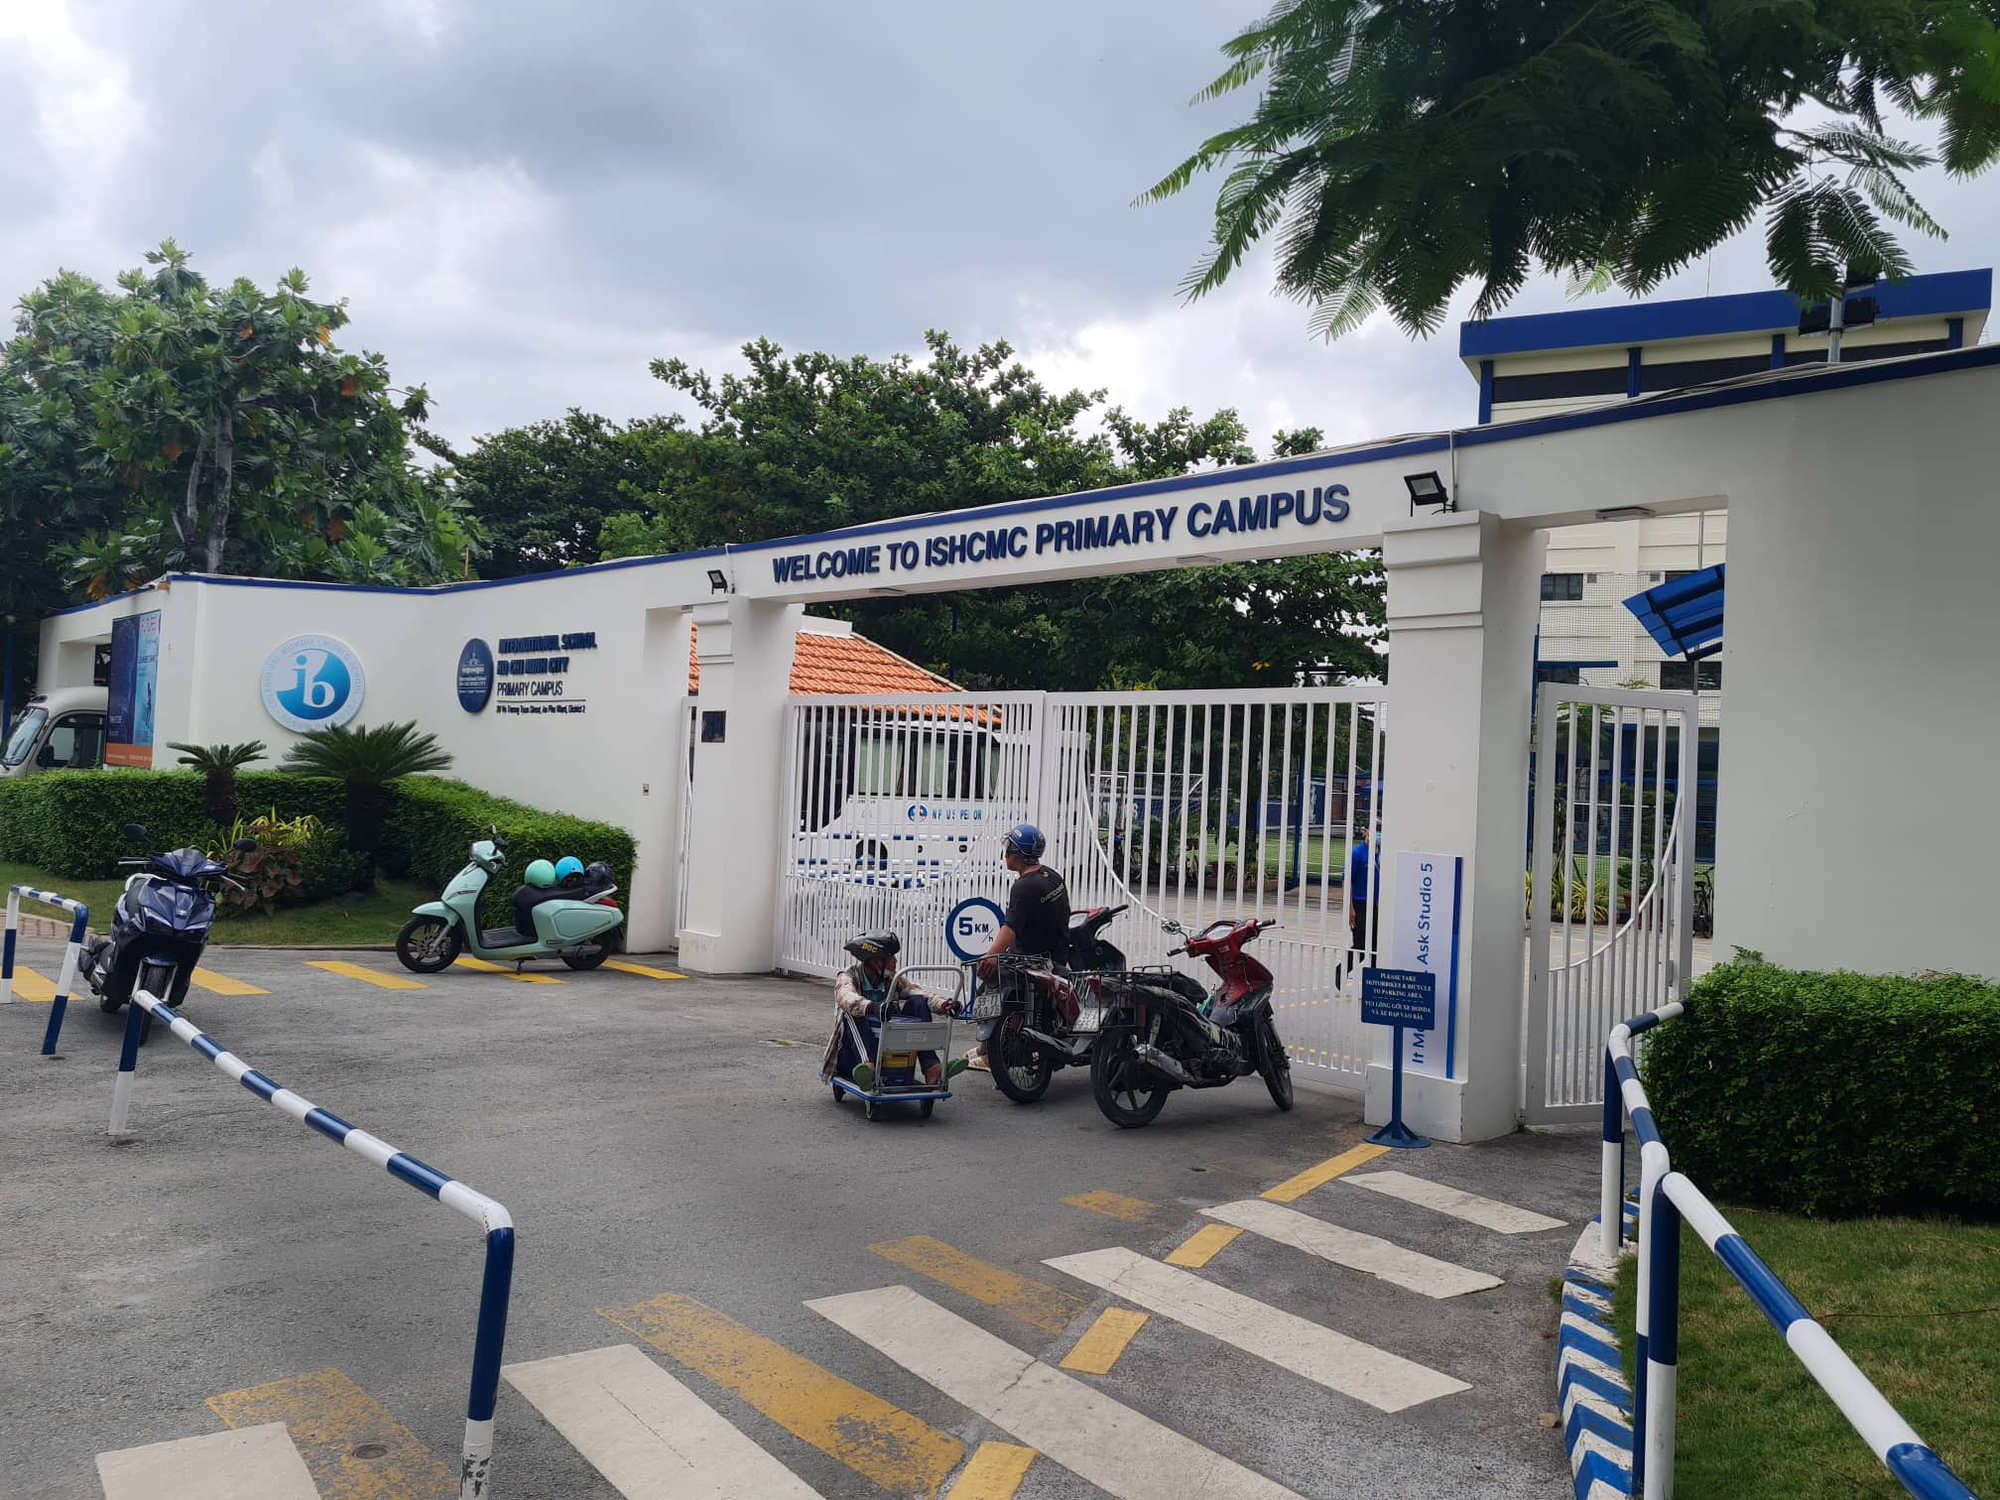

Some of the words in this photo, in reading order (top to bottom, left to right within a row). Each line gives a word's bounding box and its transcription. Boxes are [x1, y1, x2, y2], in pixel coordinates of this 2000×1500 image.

[773, 545, 880, 583] WELCOME
[886, 540, 919, 571] TO
[925, 526, 1028, 567] ISHCMC
[1035, 506, 1178, 554] PRIMARY
[1187, 484, 1350, 537] CAMPUS
[548, 657, 569, 673] CITY
[497, 682, 529, 696] PRIMARY
[530, 680, 563, 696] CAMPUS
[1420, 863, 1433, 872] 5
[1418, 877, 1432, 931] Studio
[959, 917, 973, 936] 5
[1417, 935, 1429, 965] Ask
[1380, 972, 1401, 981] PLEASE
[1381, 989, 1407, 997] PARKING
[1407, 984, 1431, 992] BICYCLE
[1411, 1005, 1431, 1013] HONDA
[1412, 1052, 1424, 1064] It
